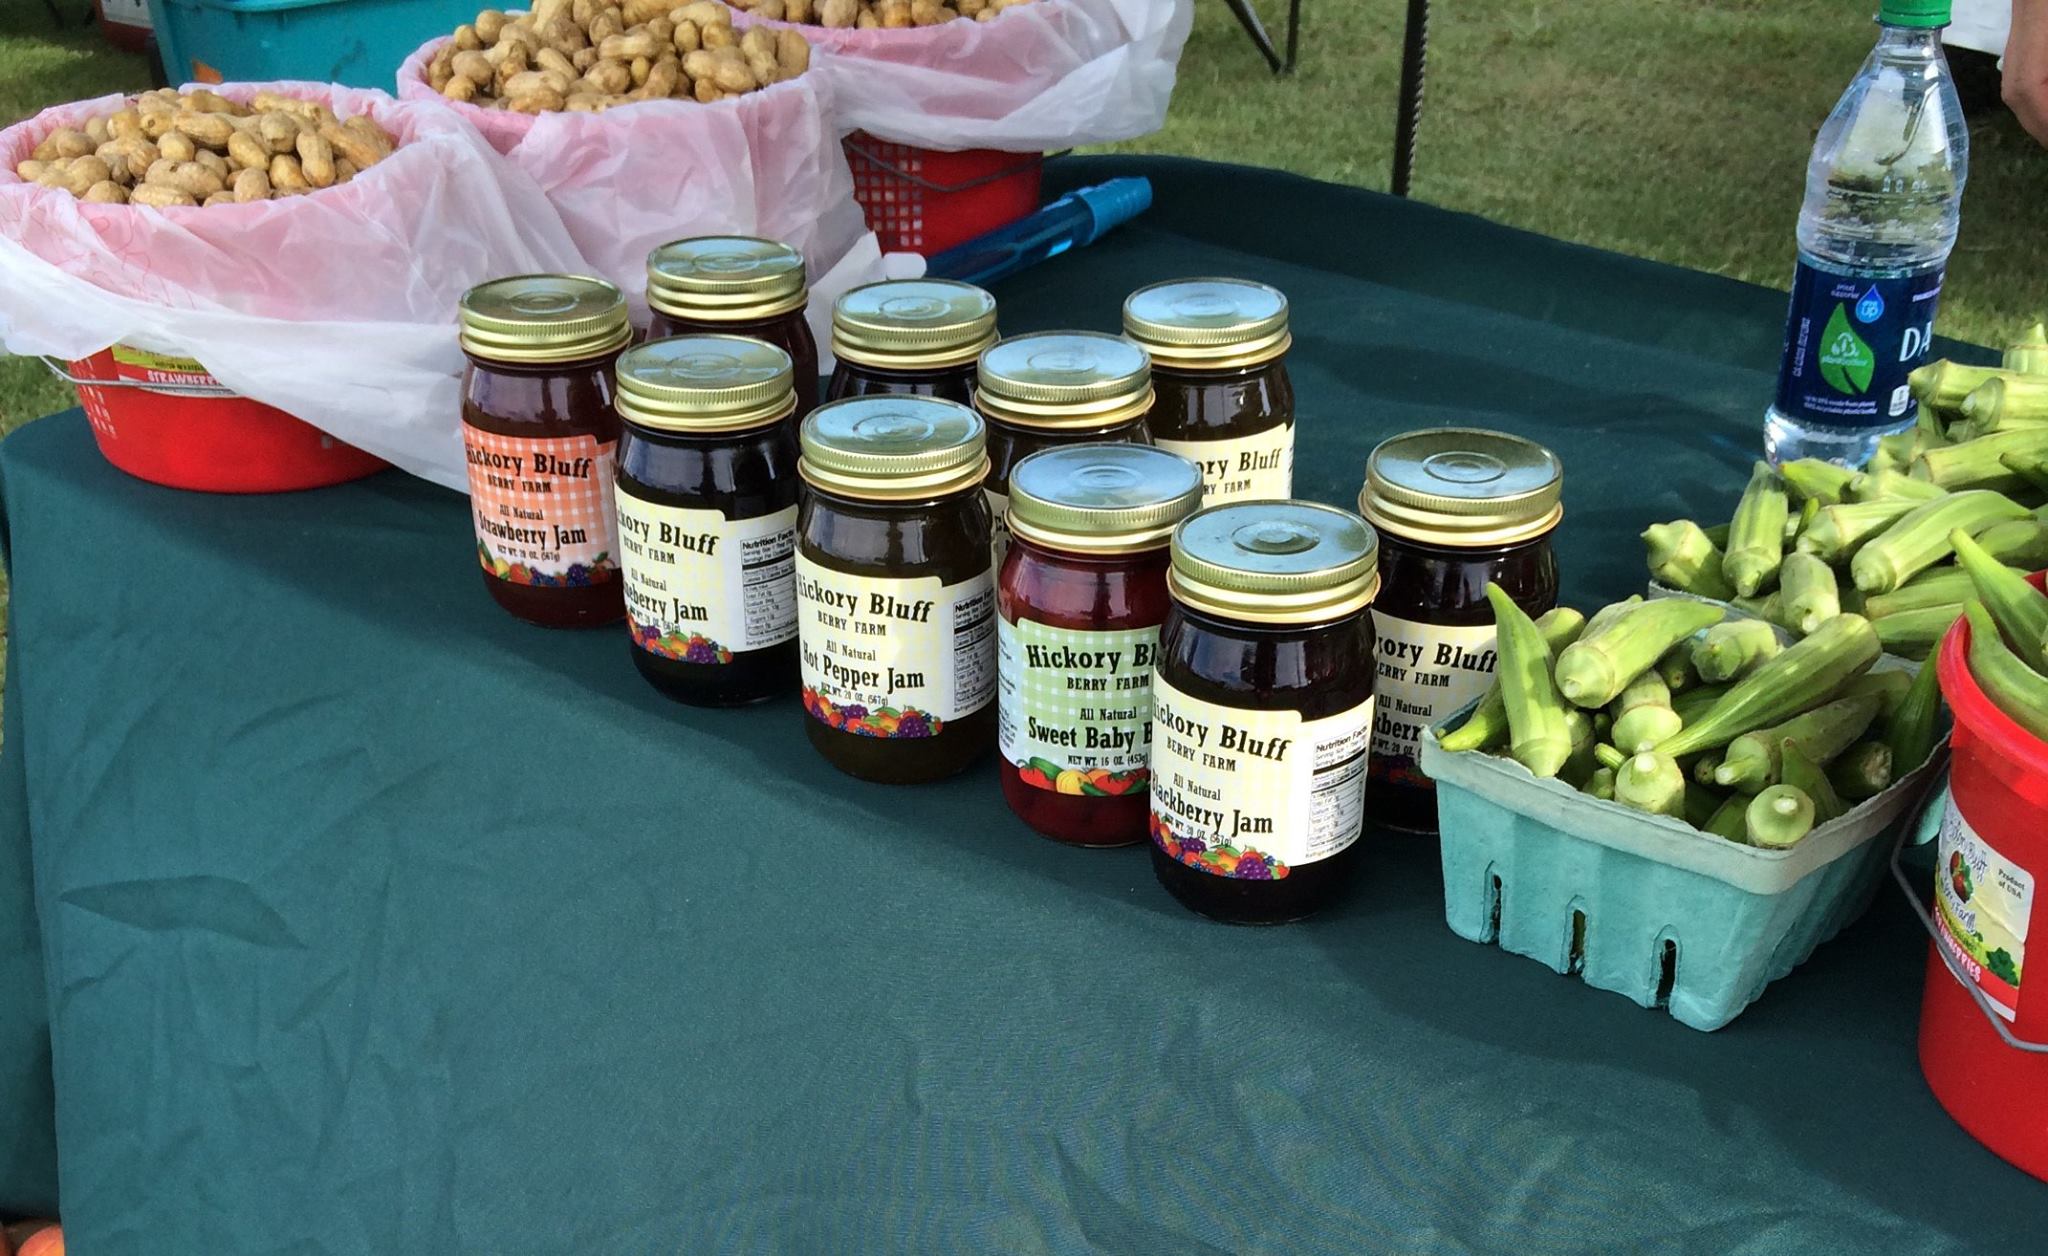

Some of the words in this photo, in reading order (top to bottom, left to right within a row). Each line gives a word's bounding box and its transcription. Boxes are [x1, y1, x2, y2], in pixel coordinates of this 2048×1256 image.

[1899, 321, 1932, 362] DA
[533, 453, 593, 479] Bluff
[1238, 447, 1282, 472] Bluff
[487, 474, 515, 491] BERRY
[522, 480, 552, 493] FARM
[1224, 479, 1251, 494] FARM
[500, 504, 510, 516] All
[513, 506, 544, 521] Natural
[479, 511, 546, 550] Strawberry
[554, 525, 587, 550] Jam
[659, 521, 720, 556] Bluff
[649, 547, 676, 565] FARM
[641, 571, 667, 592] Natural
[674, 598, 709, 624] Jam
[869, 592, 935, 623] Bluff
[817, 610, 847, 631] BERRY
[855, 621, 887, 637] FARM
[826, 639, 837, 653] All
[842, 643, 876, 662] Natural
[1026, 644, 1122, 675] Hickory
[803, 639, 819, 672] Hot
[823, 654, 880, 691] Pepper
[887, 667, 925, 695] Jam
[1378, 662, 1408, 682] ERRY
[1414, 672, 1451, 688] FARM
[1067, 676, 1108, 692] BERRY
[1116, 674, 1150, 691] FARM
[1080, 707, 1095, 721] All
[1099, 706, 1137, 721] Natural
[1378, 694, 1391, 709] All
[1395, 698, 1433, 717] Natural
[1028, 715, 1078, 748] Sweet
[1085, 726, 1136, 754] Baby
[1219, 724, 1293, 762] Bluff
[1316, 734, 1351, 754] Nutrition
[1068, 754, 1082, 765] NET
[1084, 756, 1099, 767] WT.
[1101, 757, 1110, 767] 16
[1167, 736, 1196, 762] BERRY
[1202, 753, 1237, 773] FARM
[1173, 772, 1184, 789] All
[1187, 779, 1221, 801] Natural
[1232, 809, 1274, 838] Jam
[1998, 868, 2025, 890] Product
[1998, 881, 2006, 889] of
[2007, 884, 2022, 899] USA
